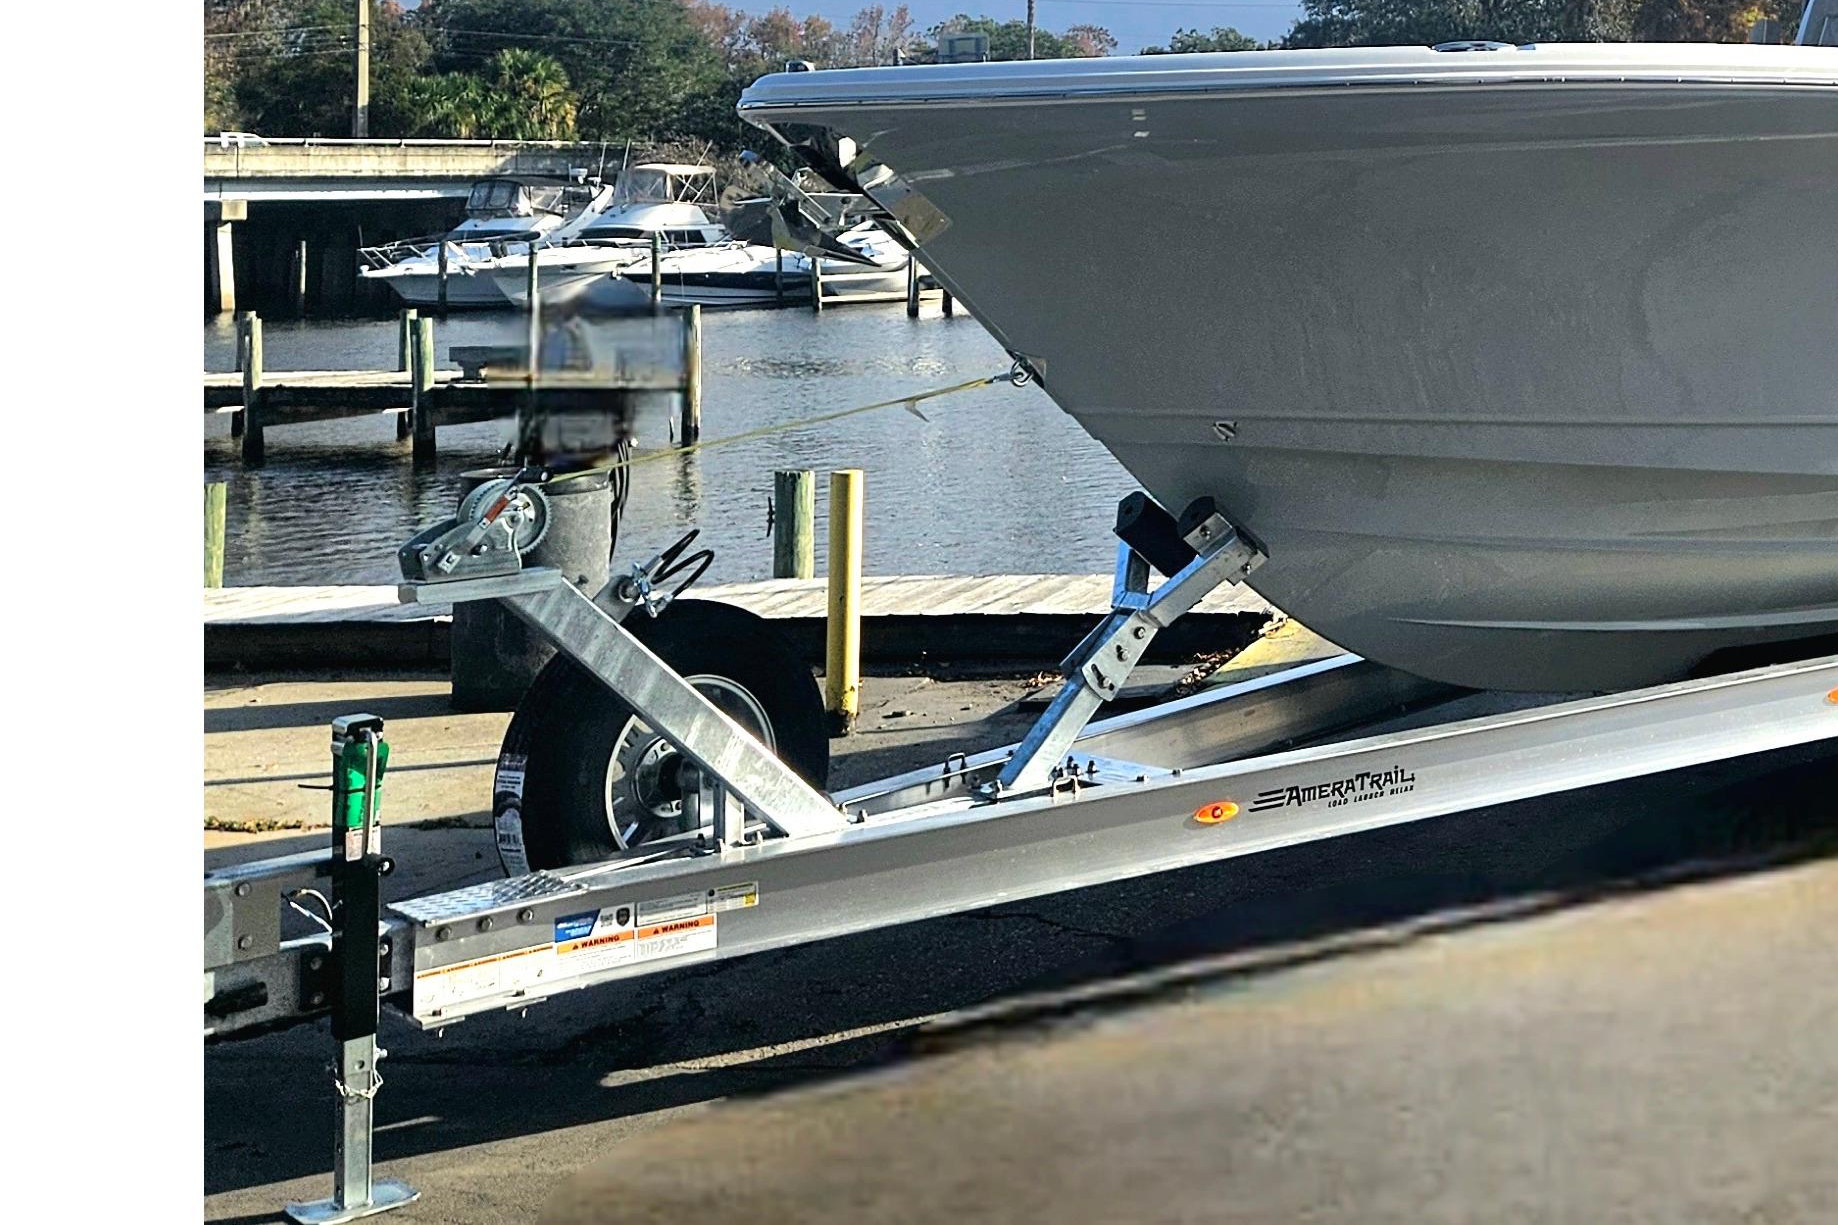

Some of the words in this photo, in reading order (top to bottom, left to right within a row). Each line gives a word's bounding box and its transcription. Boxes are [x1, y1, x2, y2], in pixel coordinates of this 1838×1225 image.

[1328, 798, 1349, 808] LOAD
[661, 919, 700, 934] WARNING
[581, 934, 620, 949] WARNING
